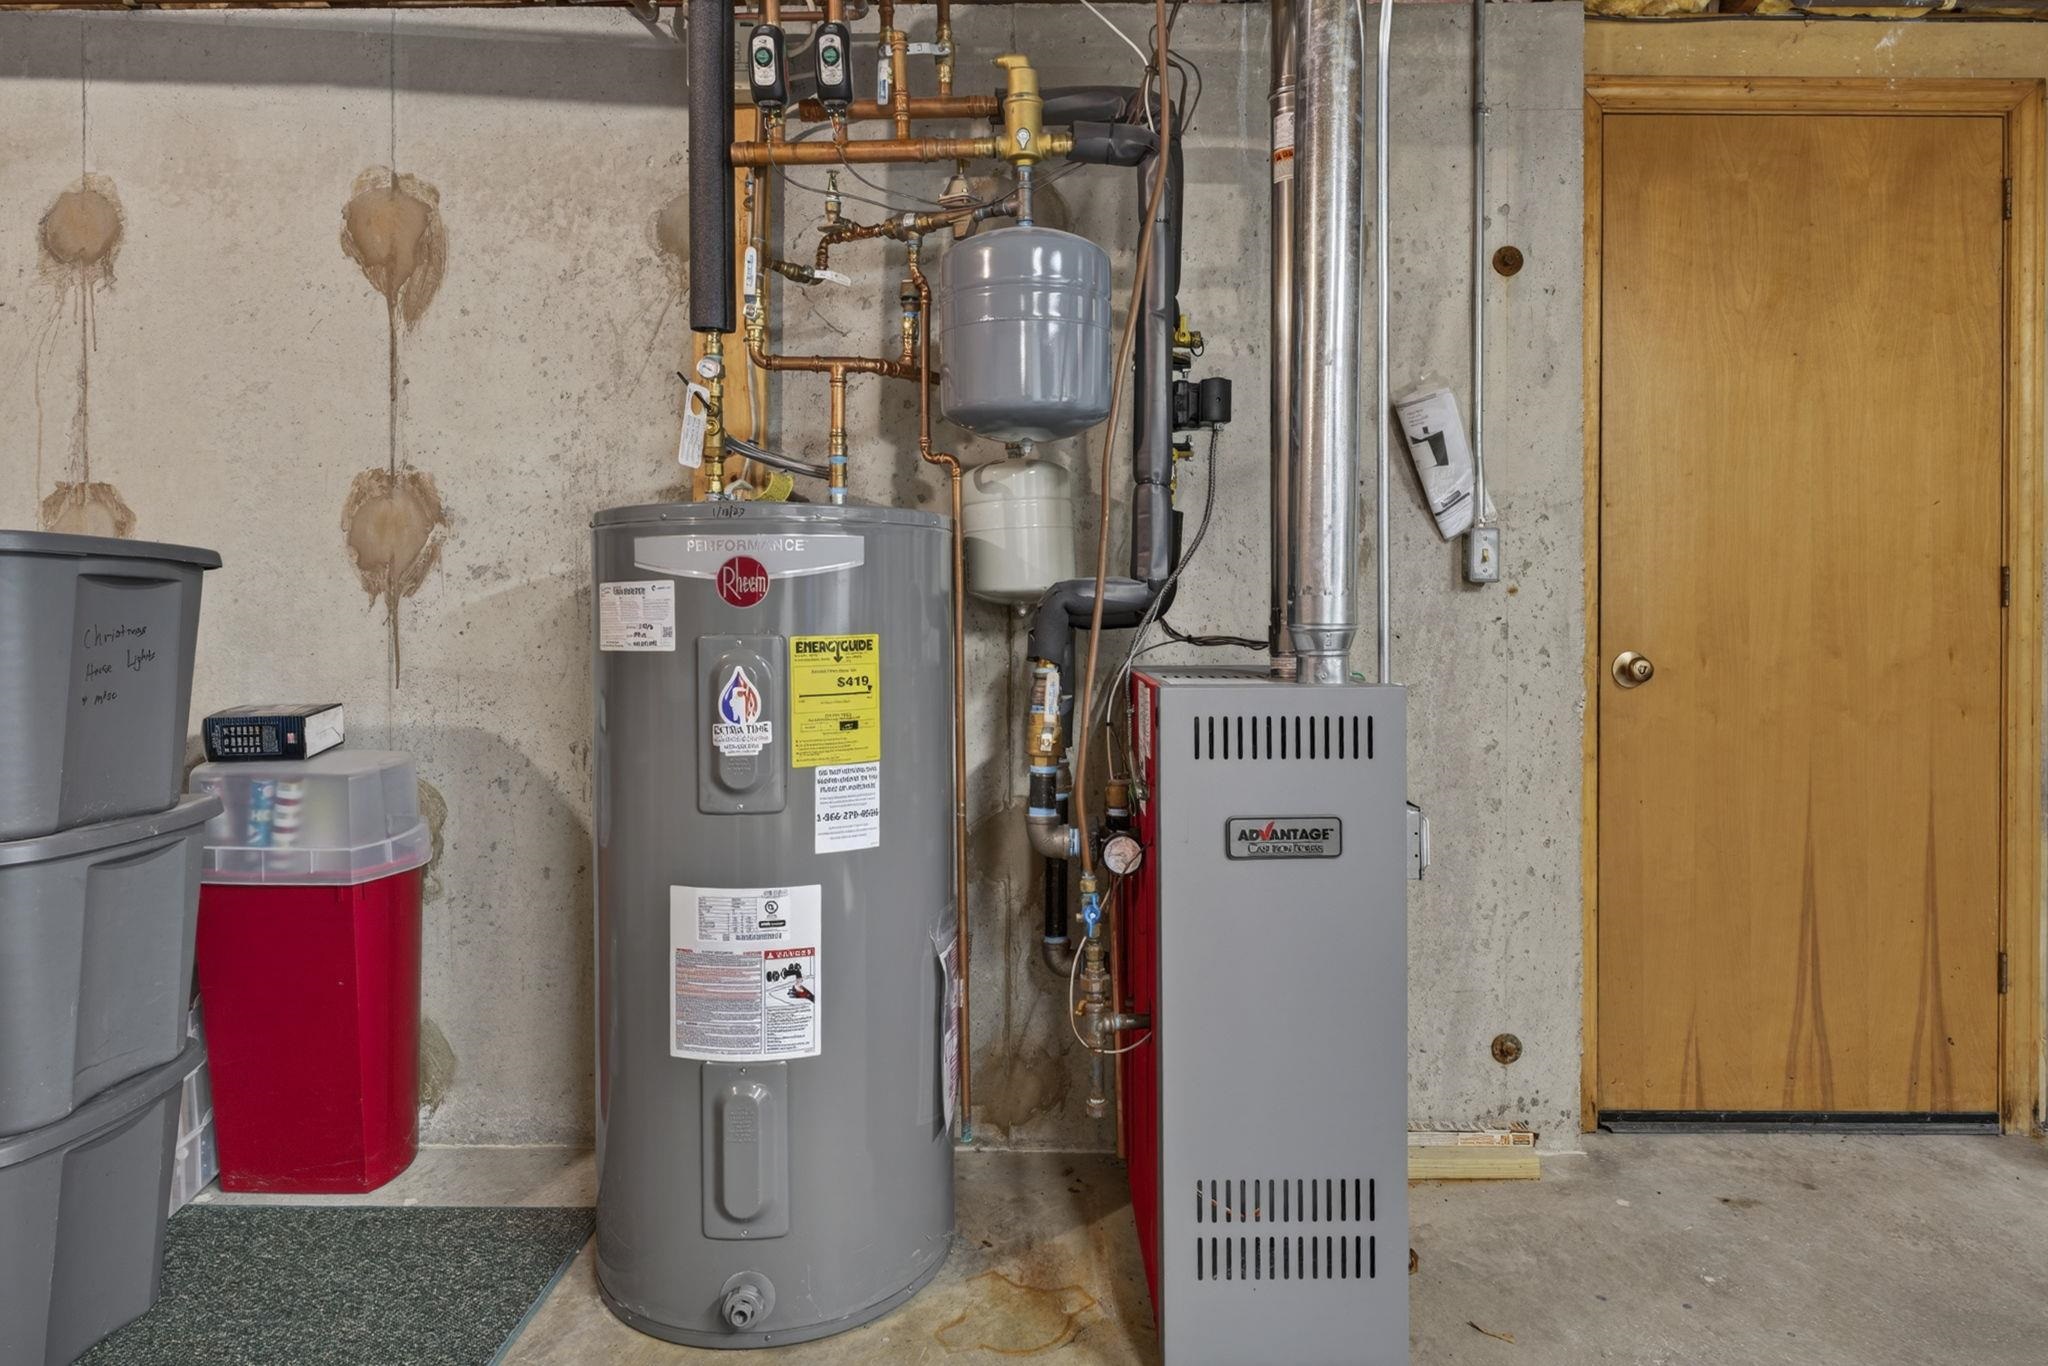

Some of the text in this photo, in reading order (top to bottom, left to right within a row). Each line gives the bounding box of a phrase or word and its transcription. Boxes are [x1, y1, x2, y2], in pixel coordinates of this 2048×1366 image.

[687, 539, 805, 552] PERFORMANCE
[723, 557, 766, 600] Rheem
[127, 648, 156, 671] Lights
[1238, 821, 1330, 841] ADVANTAGE
